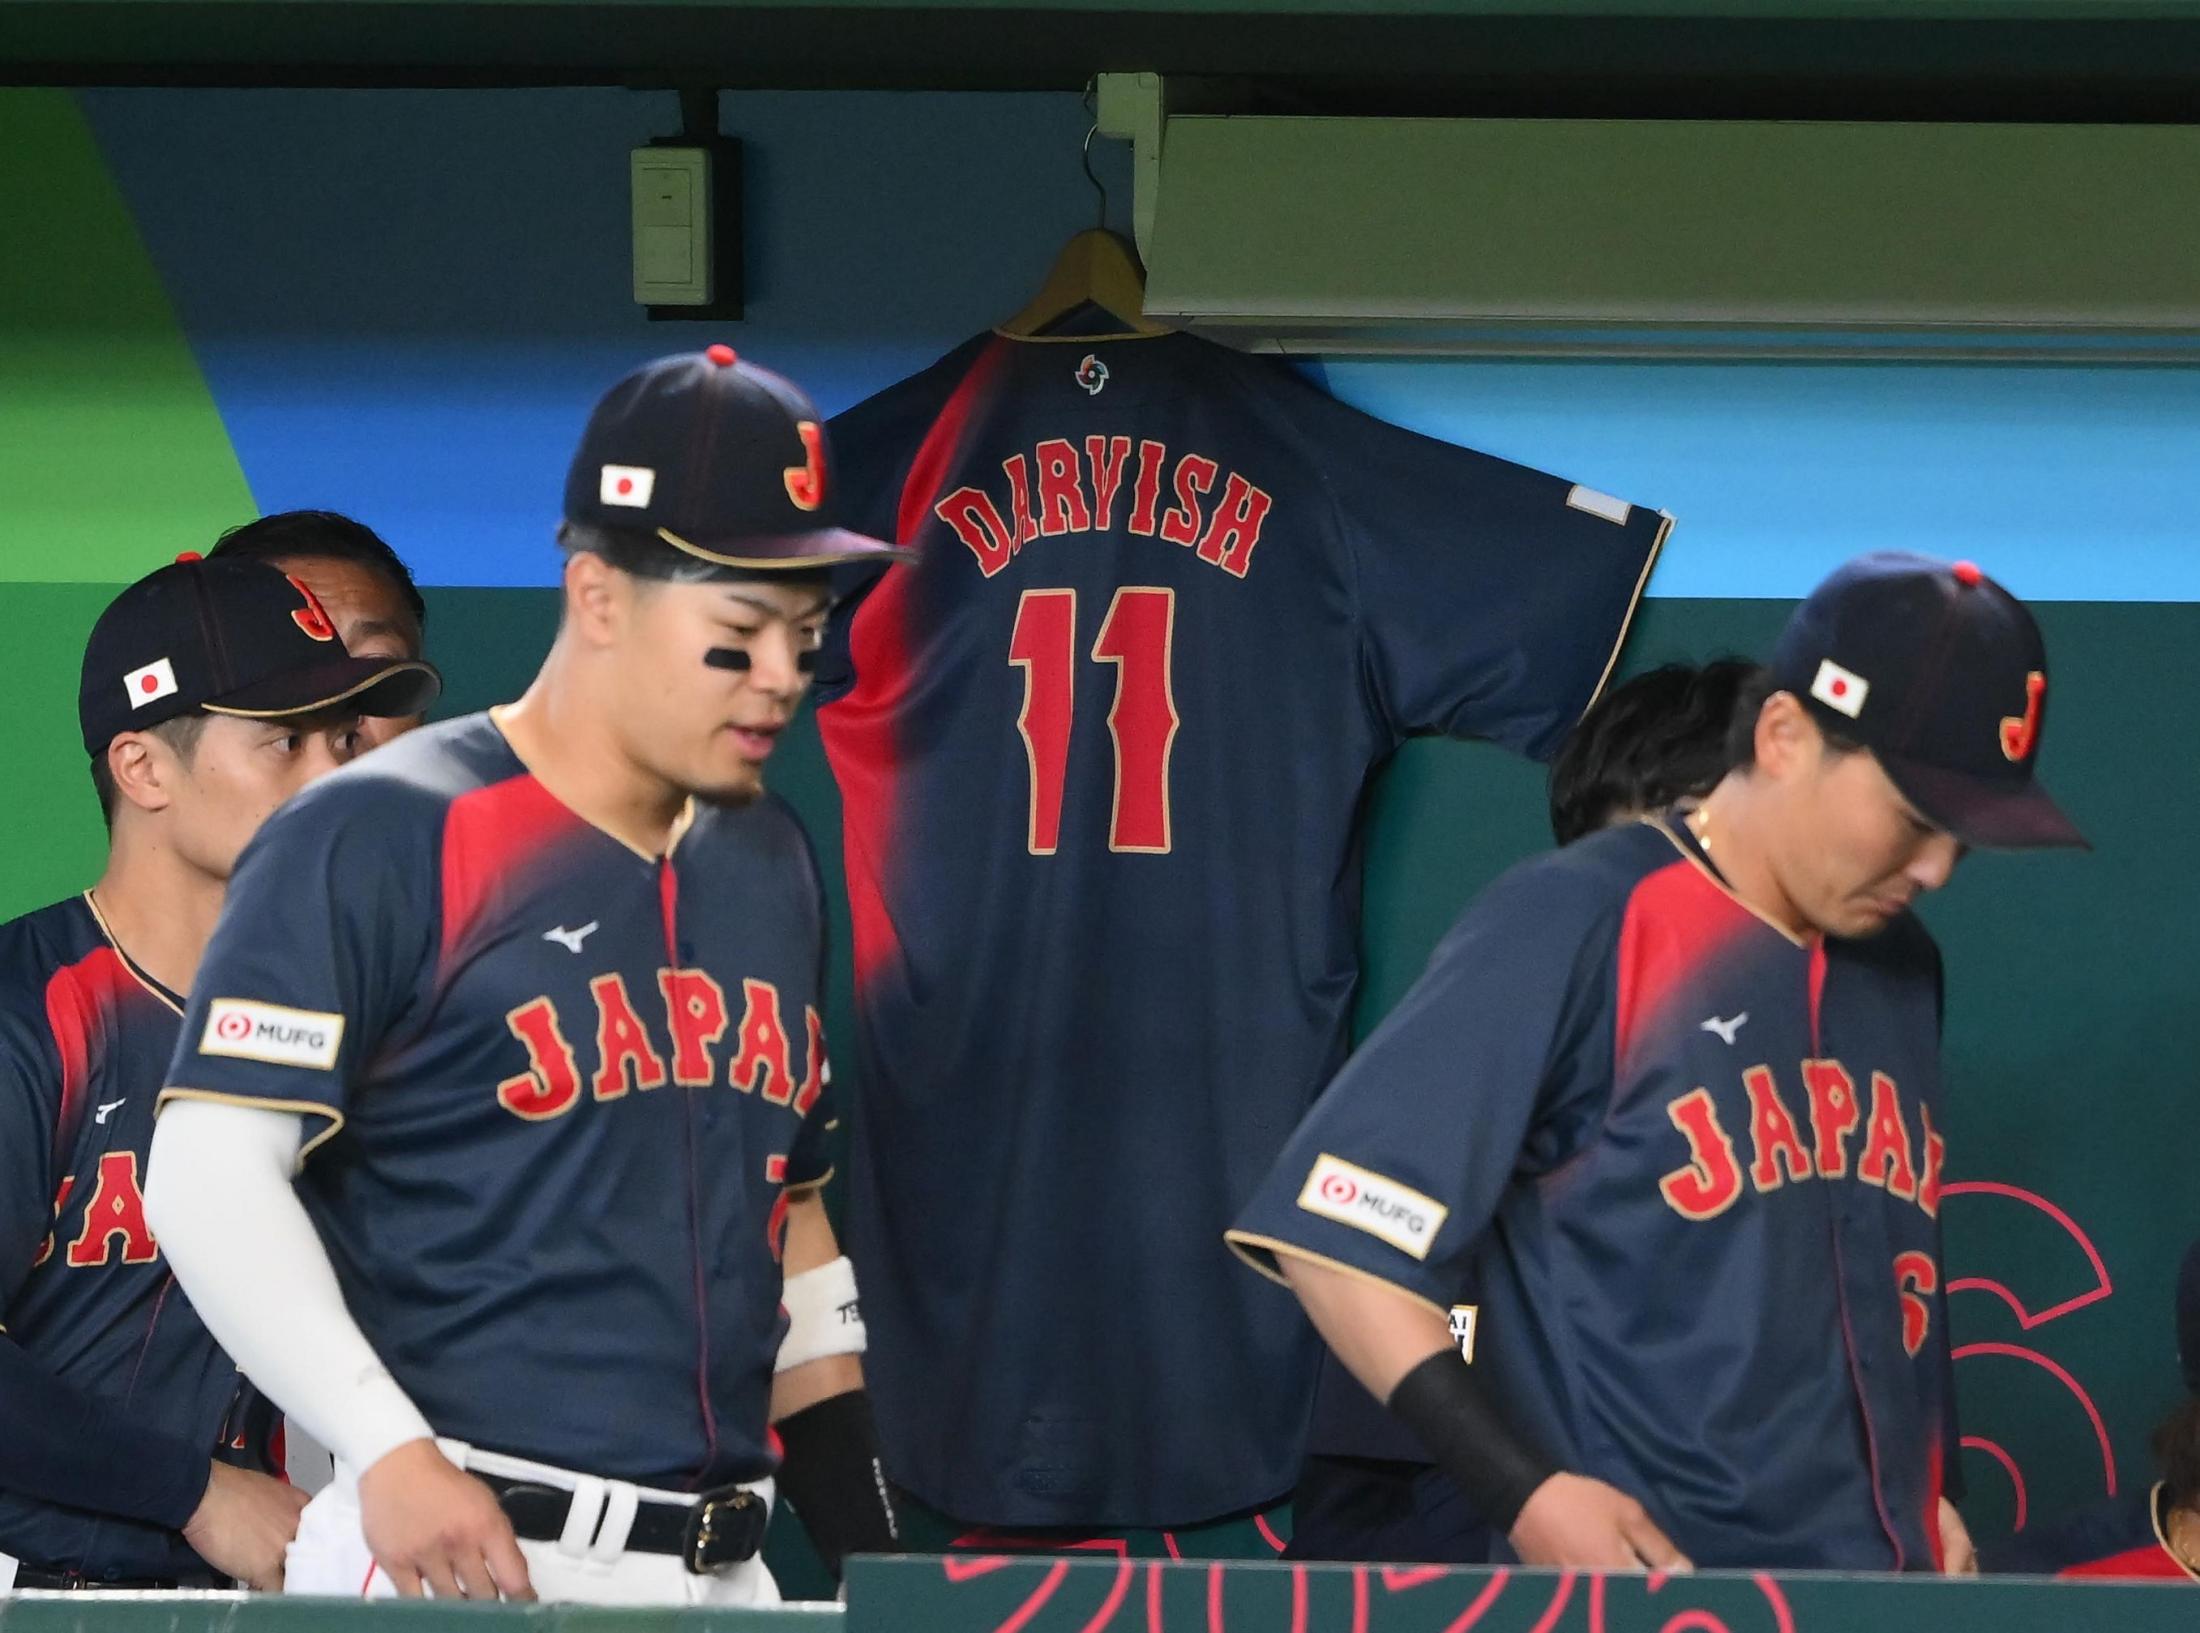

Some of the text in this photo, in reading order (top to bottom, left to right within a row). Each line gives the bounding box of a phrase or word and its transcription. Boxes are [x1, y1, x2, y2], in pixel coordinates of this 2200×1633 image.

[784, 420, 823, 511] J
[934, 435, 1272, 578] DARVISH
[1008, 586, 1180, 856] 11
[1999, 671, 2046, 762] J
[256, 1021, 325, 1049] MUFG
[1359, 1191, 1425, 1234] MUFG
